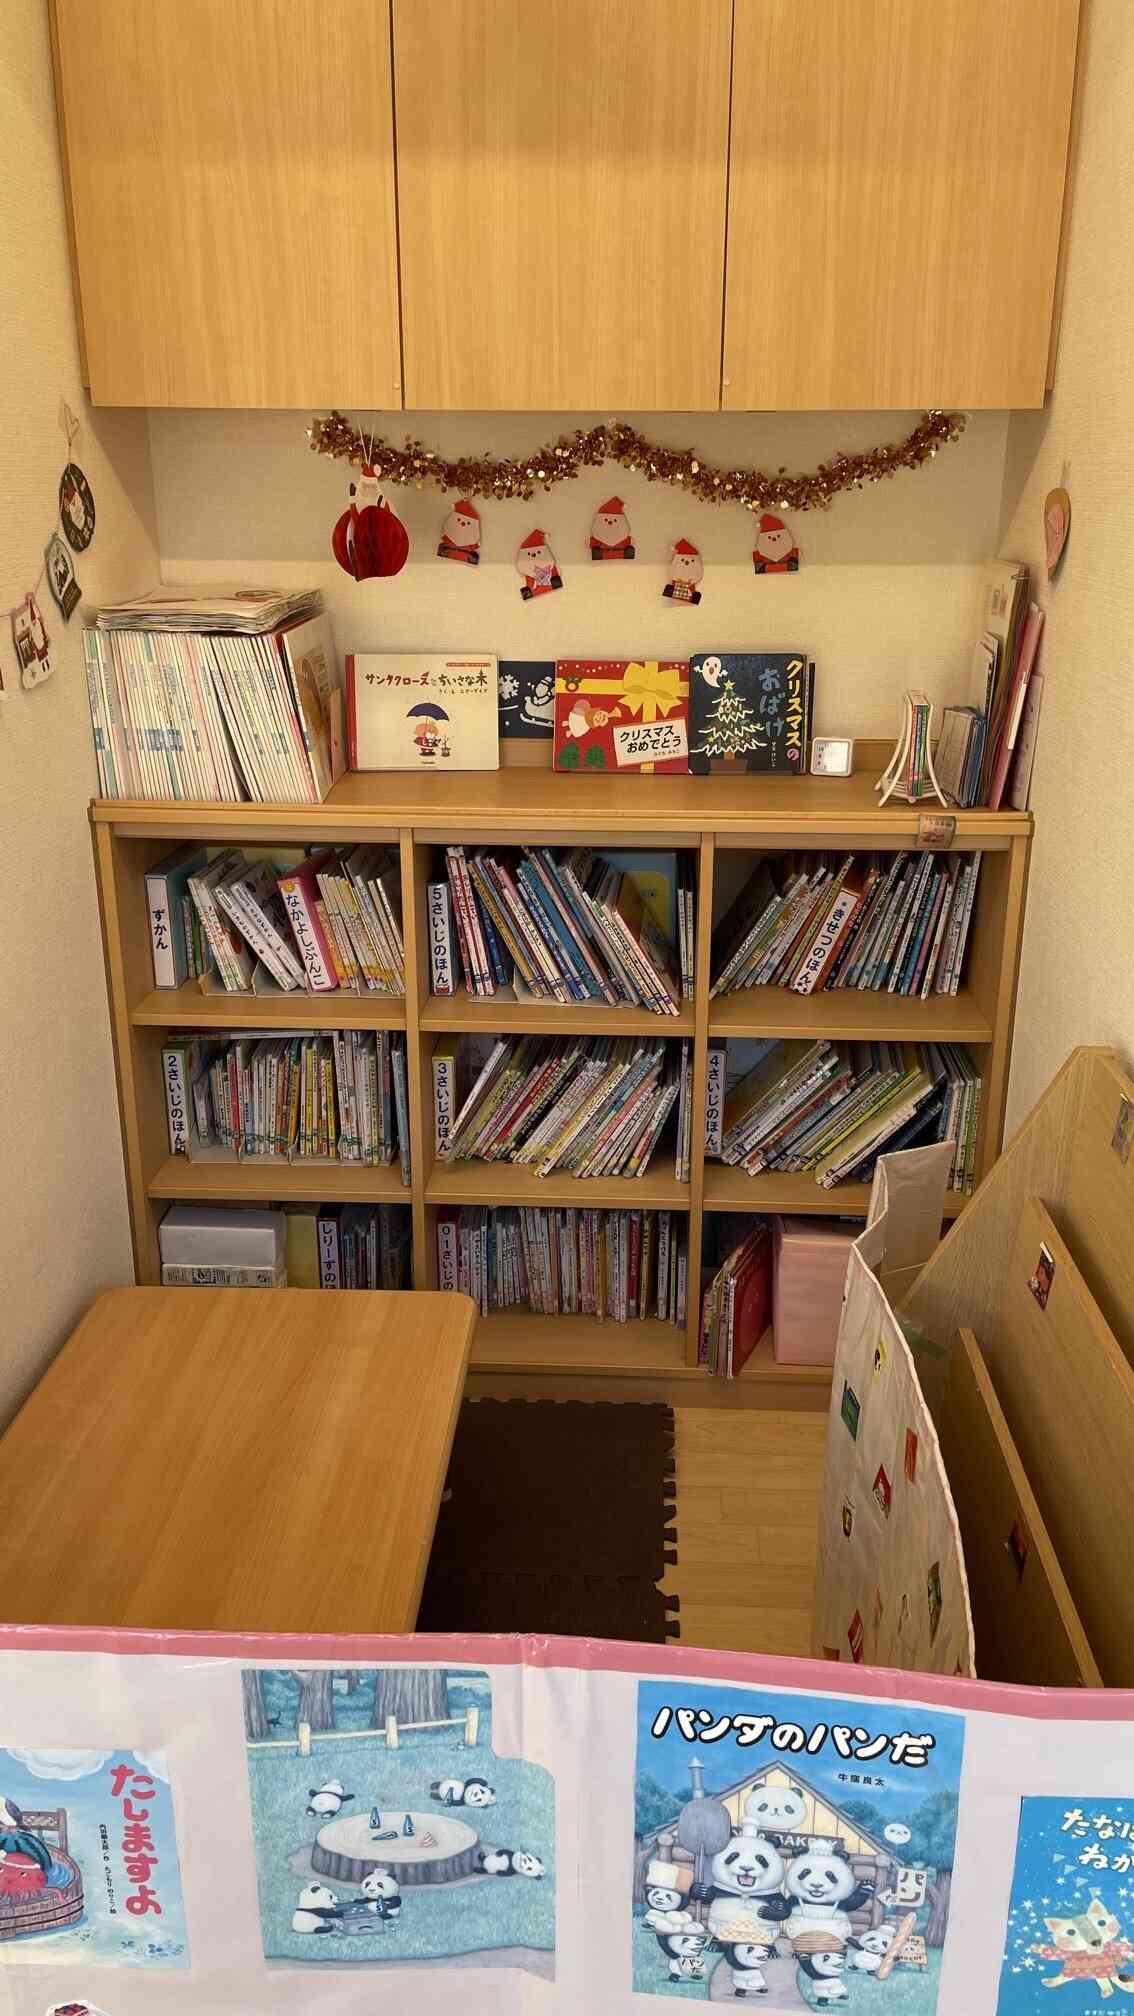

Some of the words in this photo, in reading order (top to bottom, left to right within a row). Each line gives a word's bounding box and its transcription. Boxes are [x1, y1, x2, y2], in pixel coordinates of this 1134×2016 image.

[620, 725, 675, 743] クリスマス
[627, 735, 681, 754] おめでとう
[759, 668, 785, 736] おばけ
[785, 660, 803, 761] クリスマスの
[432, 888, 449, 984] 5さいじのほん
[800, 908, 845, 984] きせつのほん
[168, 1056, 187, 1147] 2さいじのほん
[437, 1062, 451, 1151] 3さいじのほん
[705, 1054, 721, 1146] 4さいじのほん
[651, 1706, 936, 1768] パンダのパンだ
[110, 1764, 162, 1915] たしますよ
